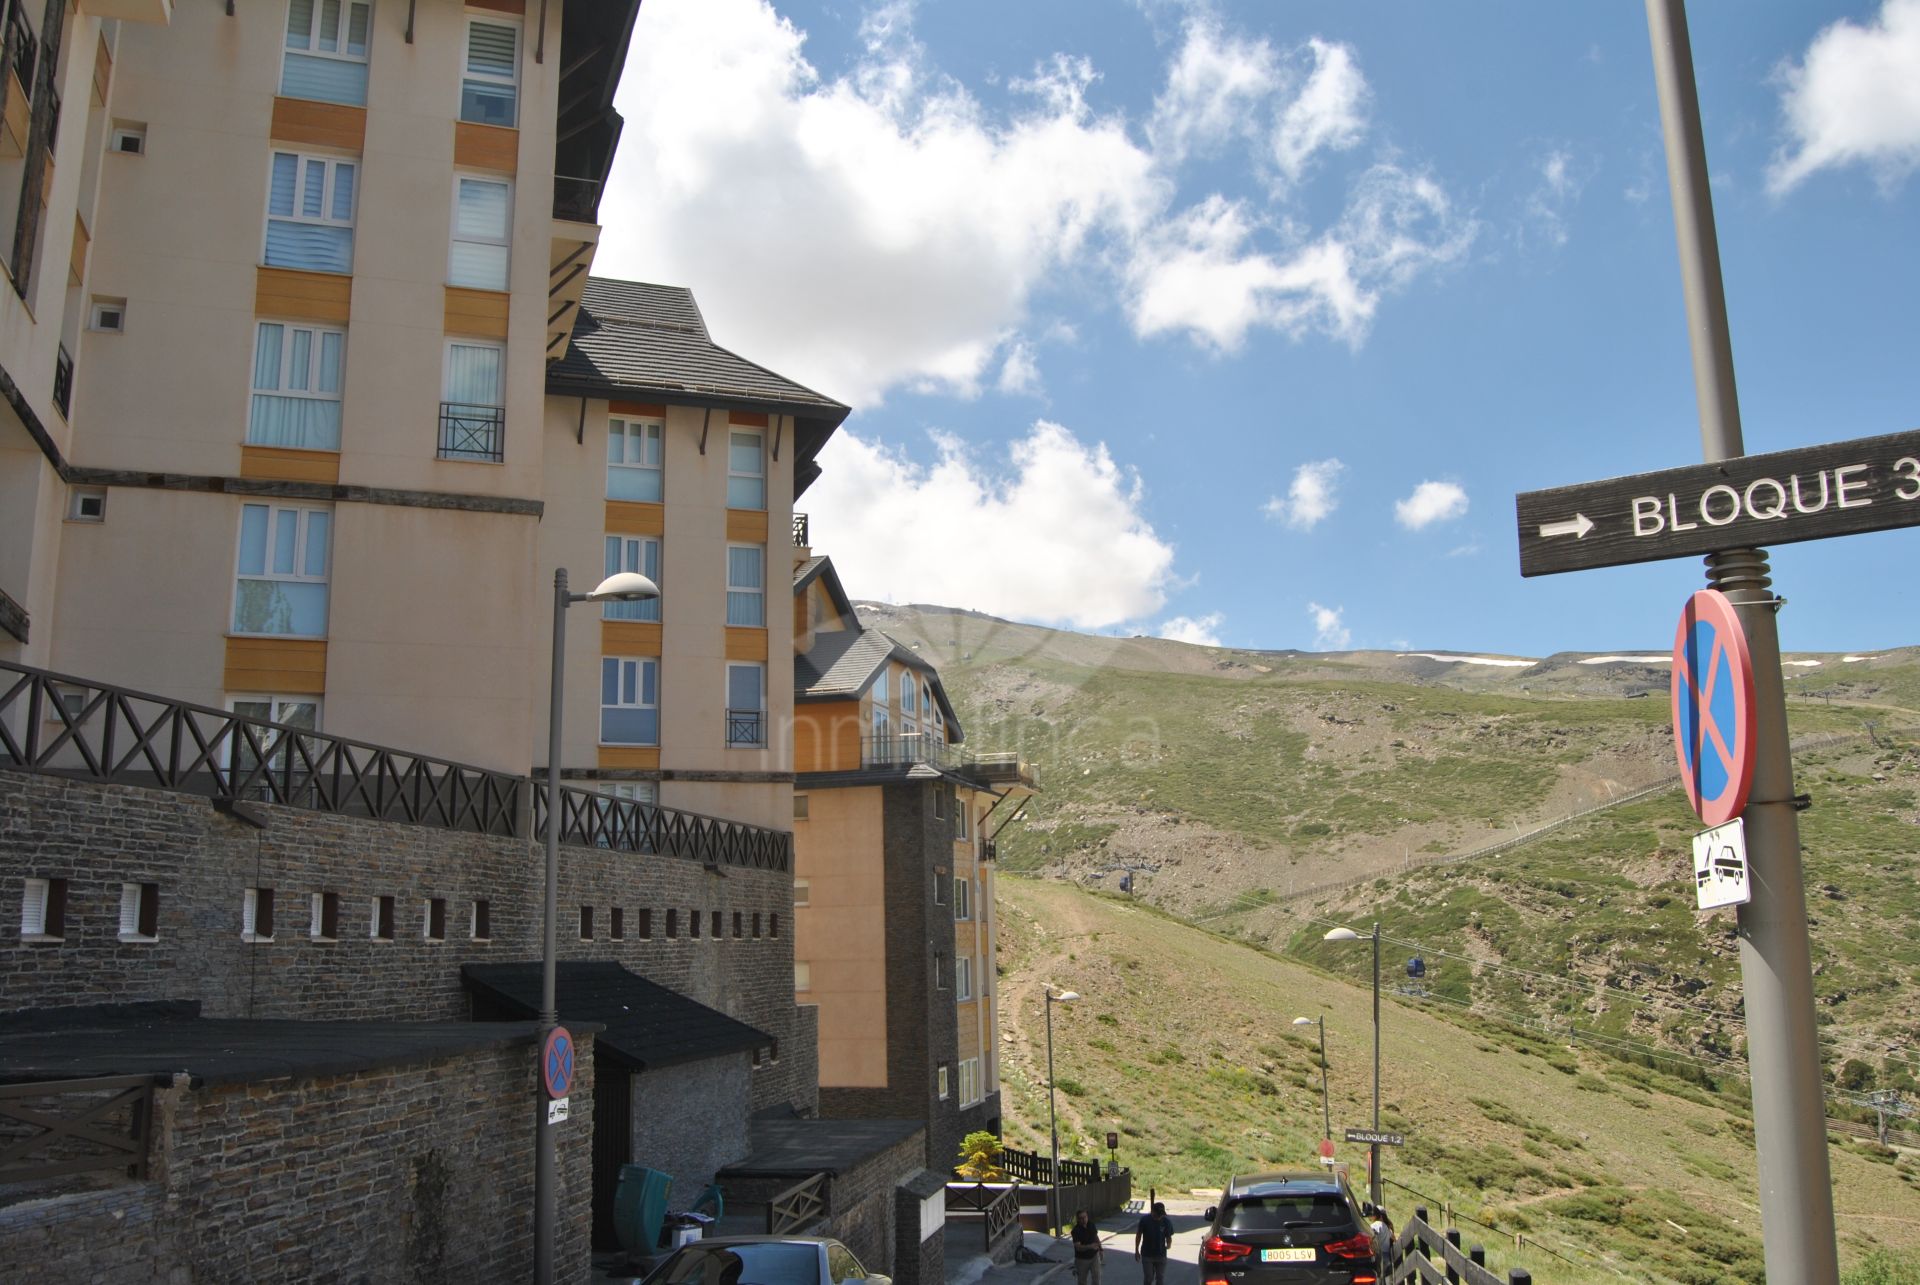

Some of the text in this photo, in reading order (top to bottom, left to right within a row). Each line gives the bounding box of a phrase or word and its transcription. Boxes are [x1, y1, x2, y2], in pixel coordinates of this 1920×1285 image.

[1631, 457, 1920, 537] BLOQUE 3
[1356, 1132, 1388, 1143] BLOQUE
[1267, 1249, 1312, 1260] 8005 LSV
